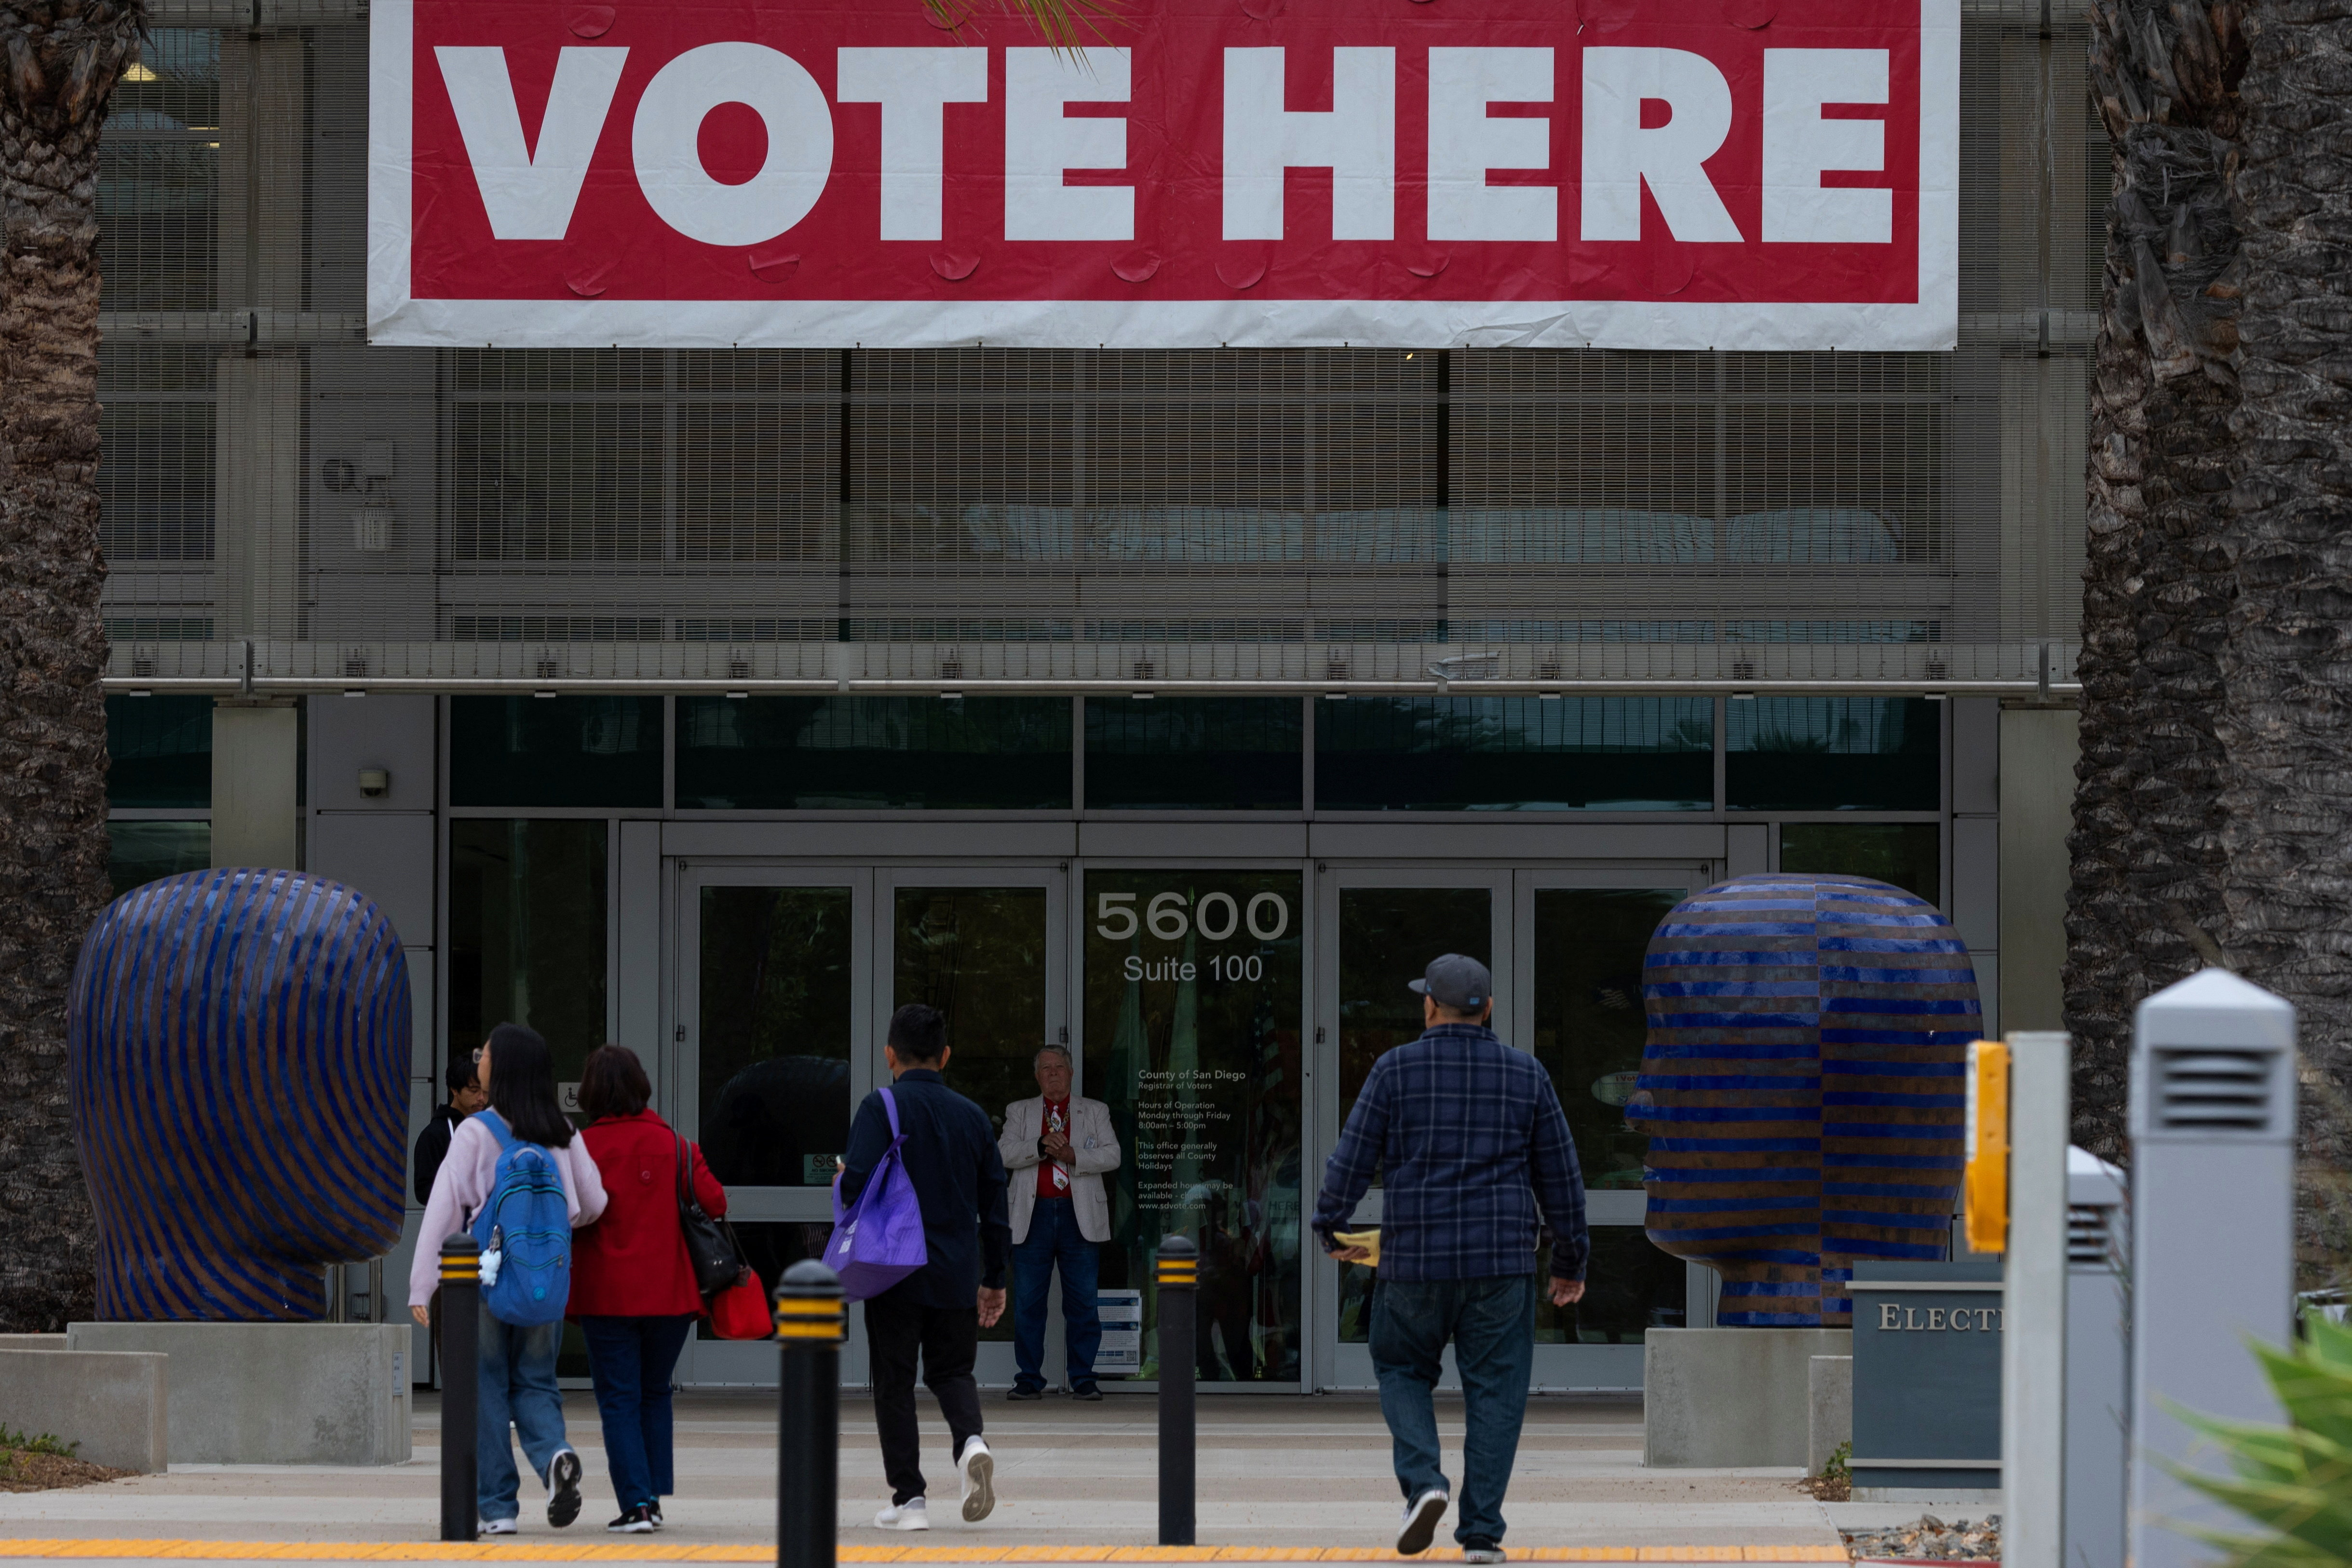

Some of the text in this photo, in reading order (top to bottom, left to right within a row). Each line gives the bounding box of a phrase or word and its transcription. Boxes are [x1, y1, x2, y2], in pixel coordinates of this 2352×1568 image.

[433, 41, 1893, 247] VOTE HERE
[1096, 892, 1289, 941] 5600
[1123, 955, 1262, 982] Suite 100
[1138, 1070, 1245, 1081] County of San Diego
[1138, 1082, 1175, 1090] Registrar
[1175, 1102, 1215, 1111] Operation
[1138, 1112, 1230, 1121] Monday through Friday
[1176, 1122, 1205, 1131] 5:00pm
[1181, 1142, 1217, 1151] generally
[1188, 1152, 1216, 1162] County
[1139, 1162, 1172, 1171] Holidays
[1138, 1182, 1177, 1191] Expanded
